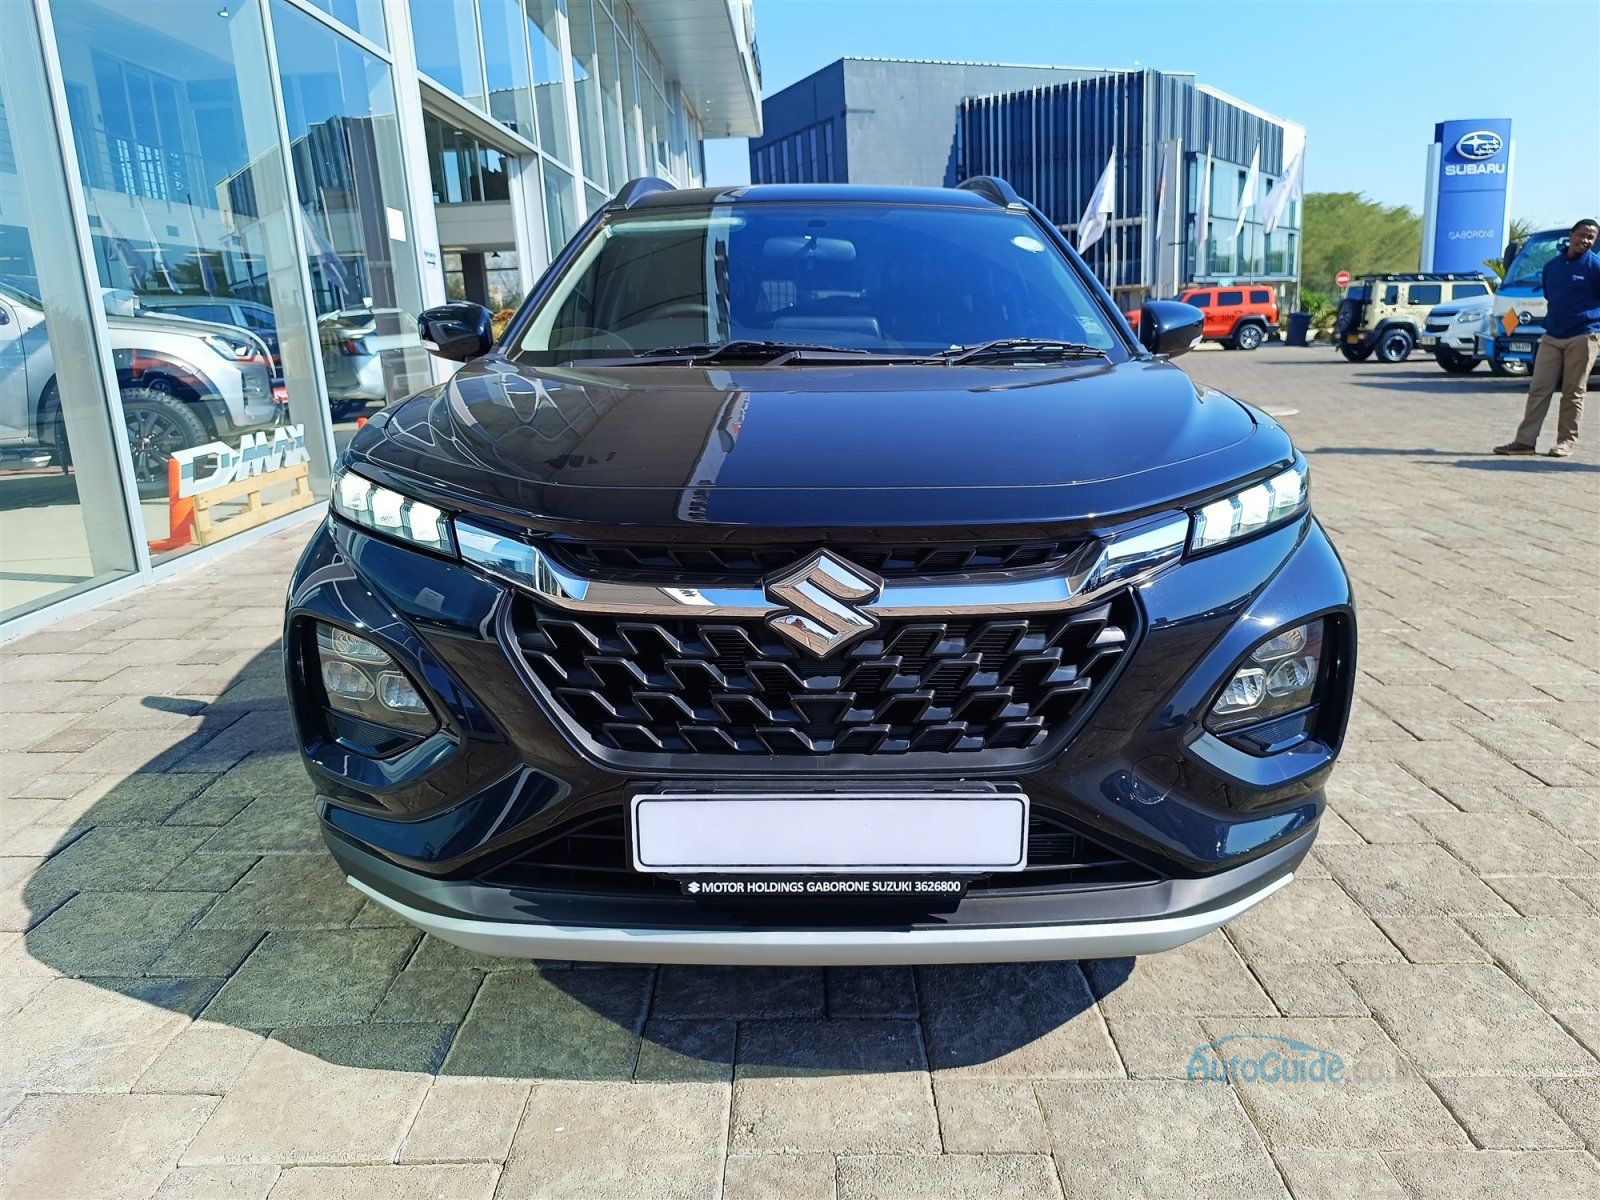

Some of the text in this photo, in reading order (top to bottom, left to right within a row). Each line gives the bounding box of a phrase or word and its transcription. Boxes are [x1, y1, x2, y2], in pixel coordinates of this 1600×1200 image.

[1444, 163, 1506, 176] SUBARU
[1448, 229, 1496, 241] GABORONE
[701, 880, 961, 893] MOTOR HOLDINGS GABORONE SUZUKI 3626800
